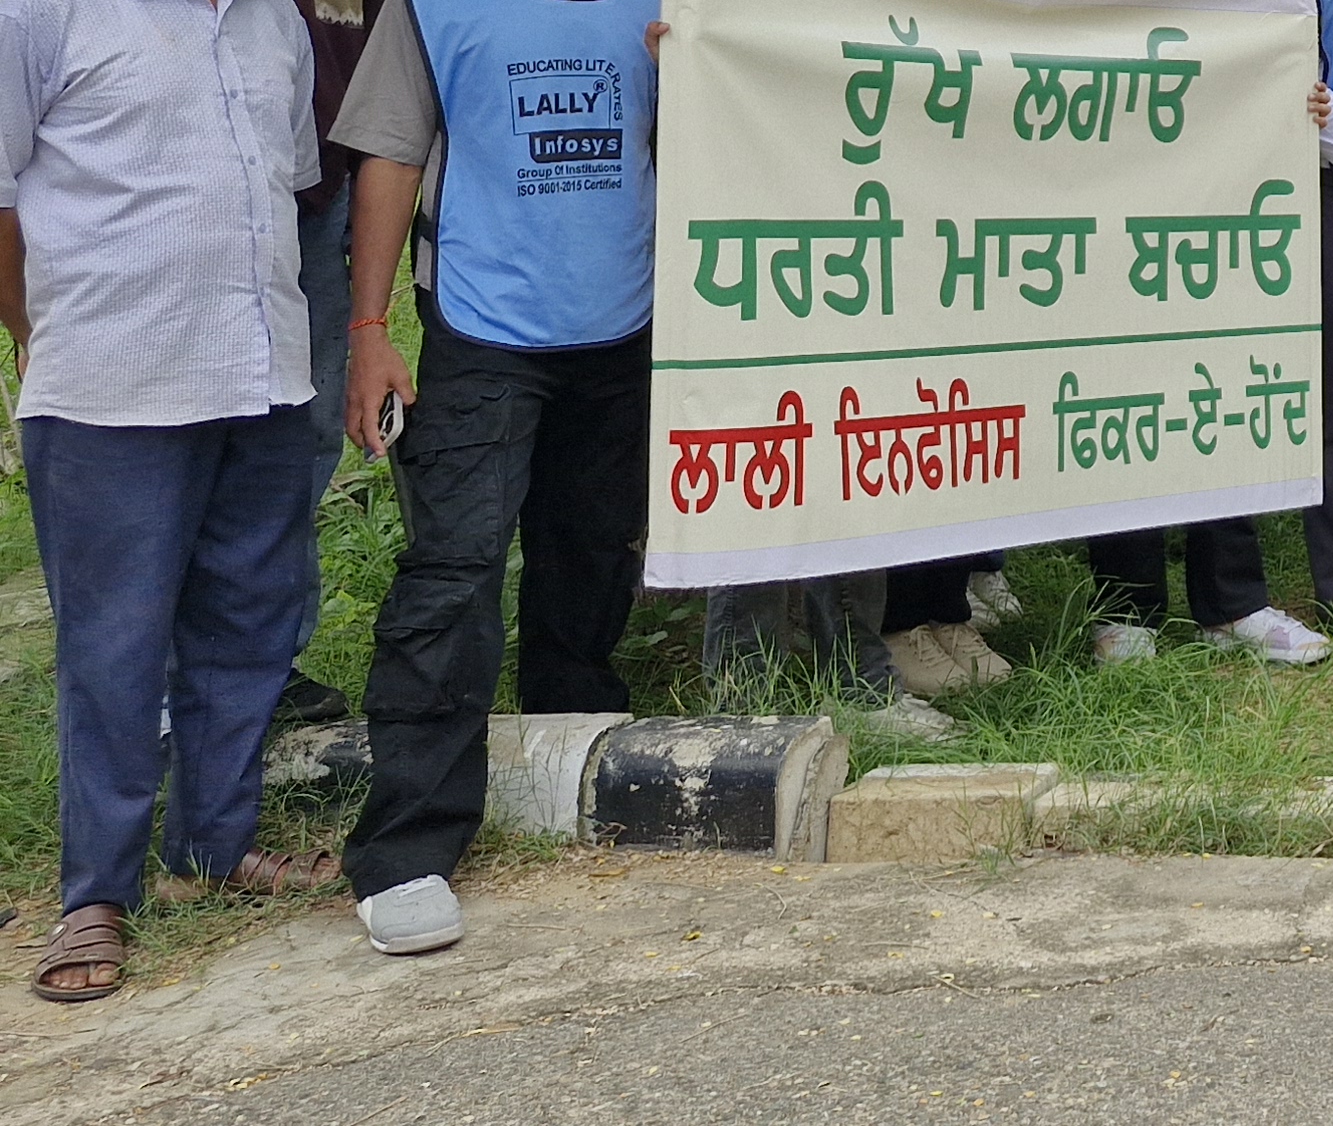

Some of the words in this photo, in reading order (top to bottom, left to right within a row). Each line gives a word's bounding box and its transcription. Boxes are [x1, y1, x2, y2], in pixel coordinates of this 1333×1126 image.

[507, 59, 582, 76] EDUCATING
[585, 59, 624, 122] LITERATES
[517, 91, 600, 118] LALLY
[841, 14, 983, 165] ਰੁੱਖ
[1010, 26, 1202, 144] ਲਗਾਓ
[534, 135, 619, 156] Infosys
[517, 168, 552, 179] Group
[566, 162, 622, 175] Institutions
[517, 183, 536, 197] ISO
[538, 179, 582, 194] 9001-2015
[584, 177, 622, 191] Certified
[687, 180, 904, 321] ਧਰਤੀ
[935, 216, 1097, 311] ਮਾਤਾ
[1125, 179, 1301, 302] ਬਚਾਓ
[669, 390, 813, 514] ਲਾਲੀ
[834, 377, 1026, 501] ਇਨਫੋਸਿਸ
